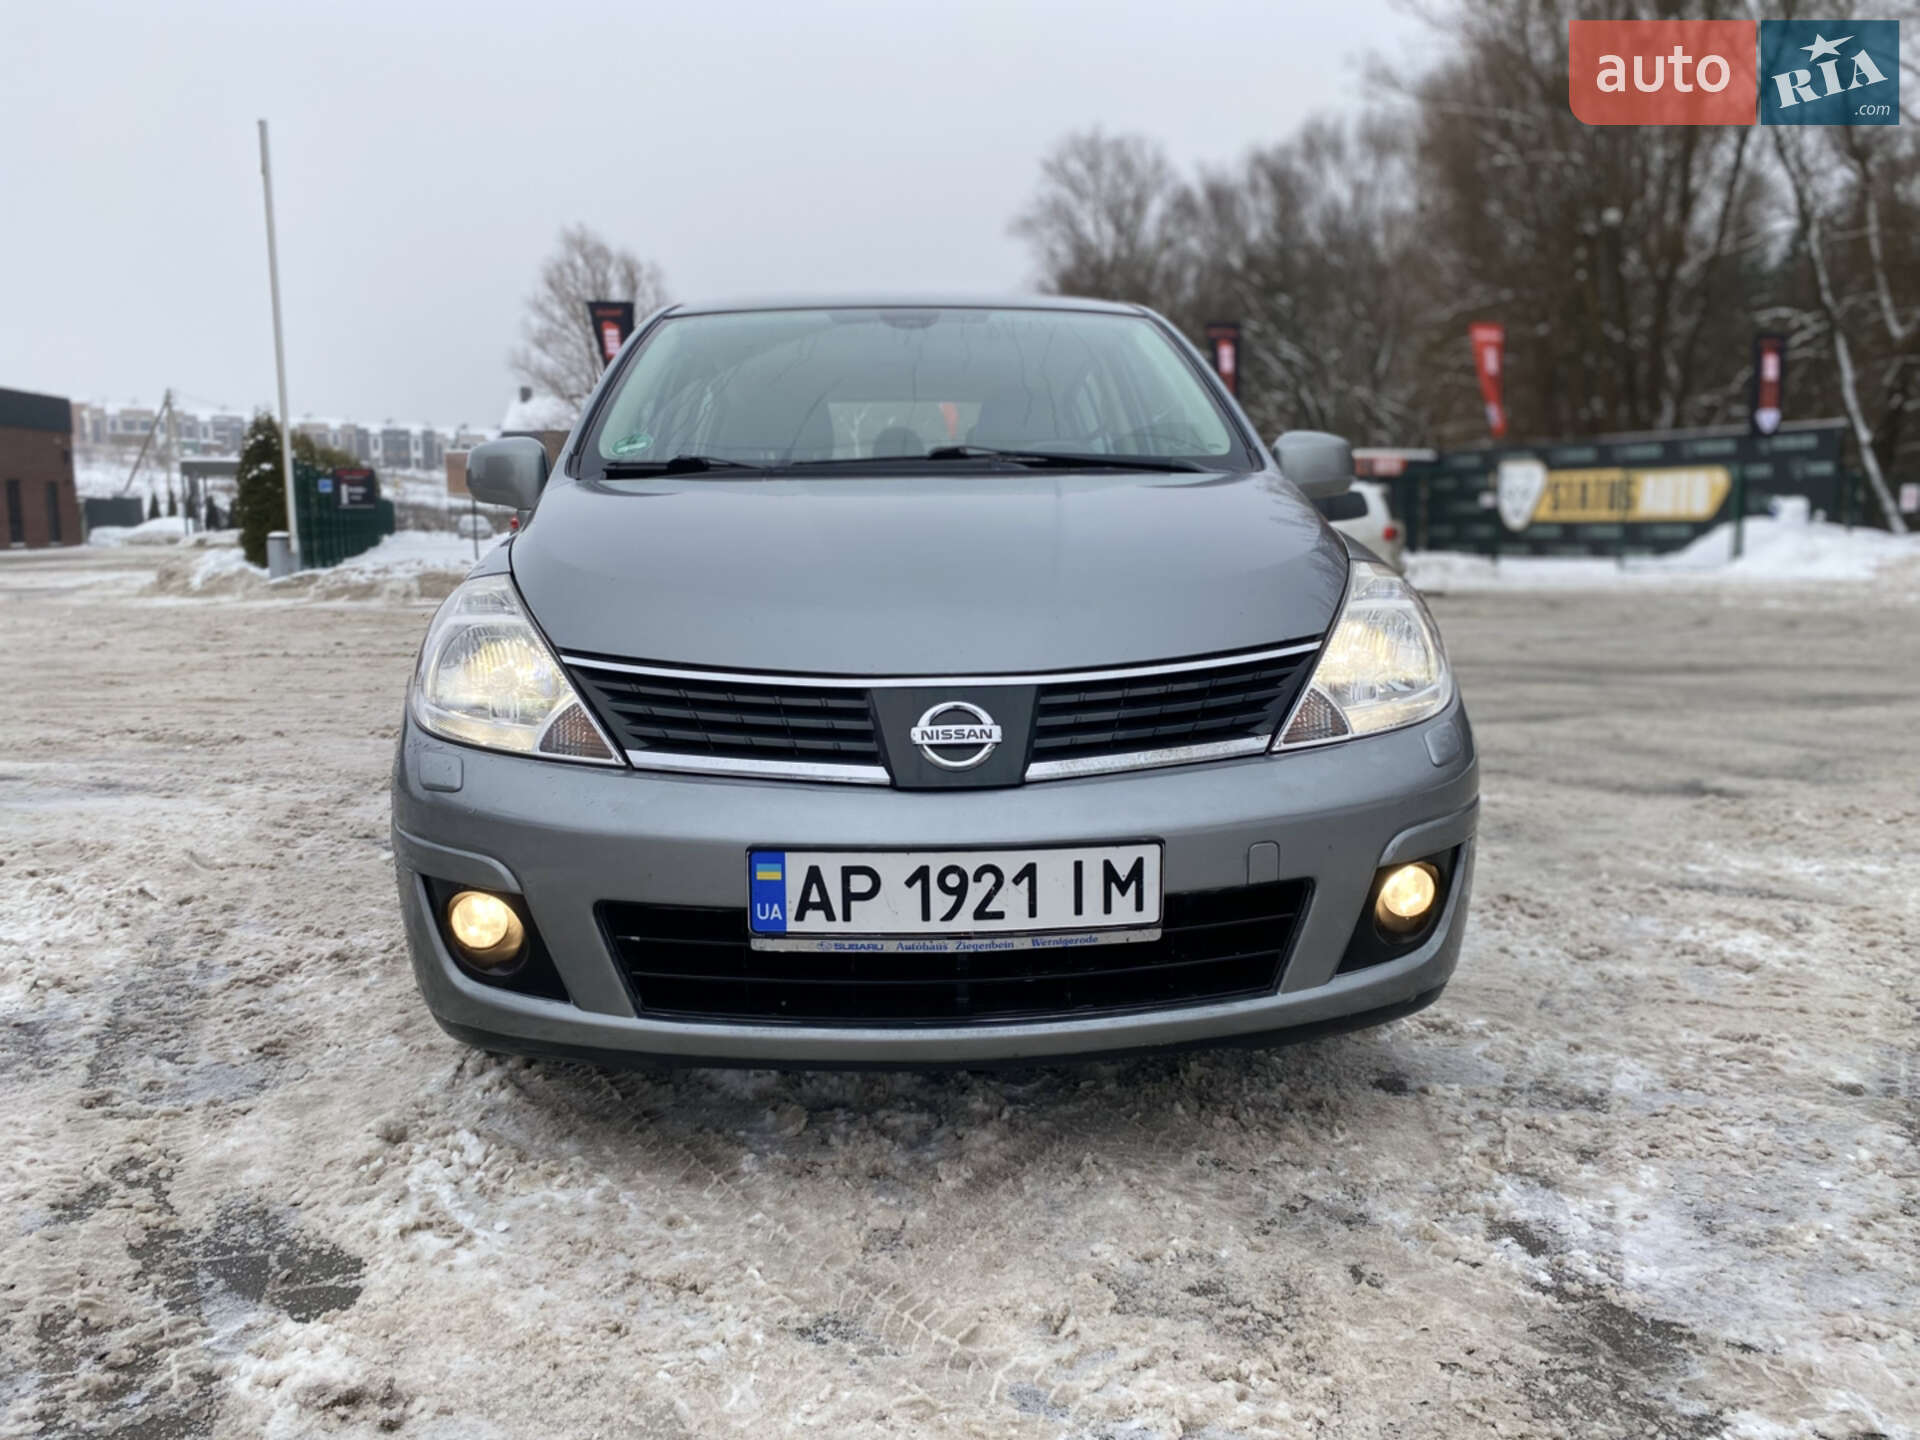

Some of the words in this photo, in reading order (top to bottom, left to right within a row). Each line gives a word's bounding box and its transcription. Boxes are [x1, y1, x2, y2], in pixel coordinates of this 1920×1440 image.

[921, 729, 992, 740] NISSAN
[794, 865, 881, 922] AP
[904, 862, 1038, 922] 1921
[1073, 856, 1145, 916] IM
[757, 903, 783, 921] UA
[834, 942, 884, 951] SUBARU
[955, 940, 1014, 951] Ziegenbein
[1031, 935, 1098, 947] Wernigerode
